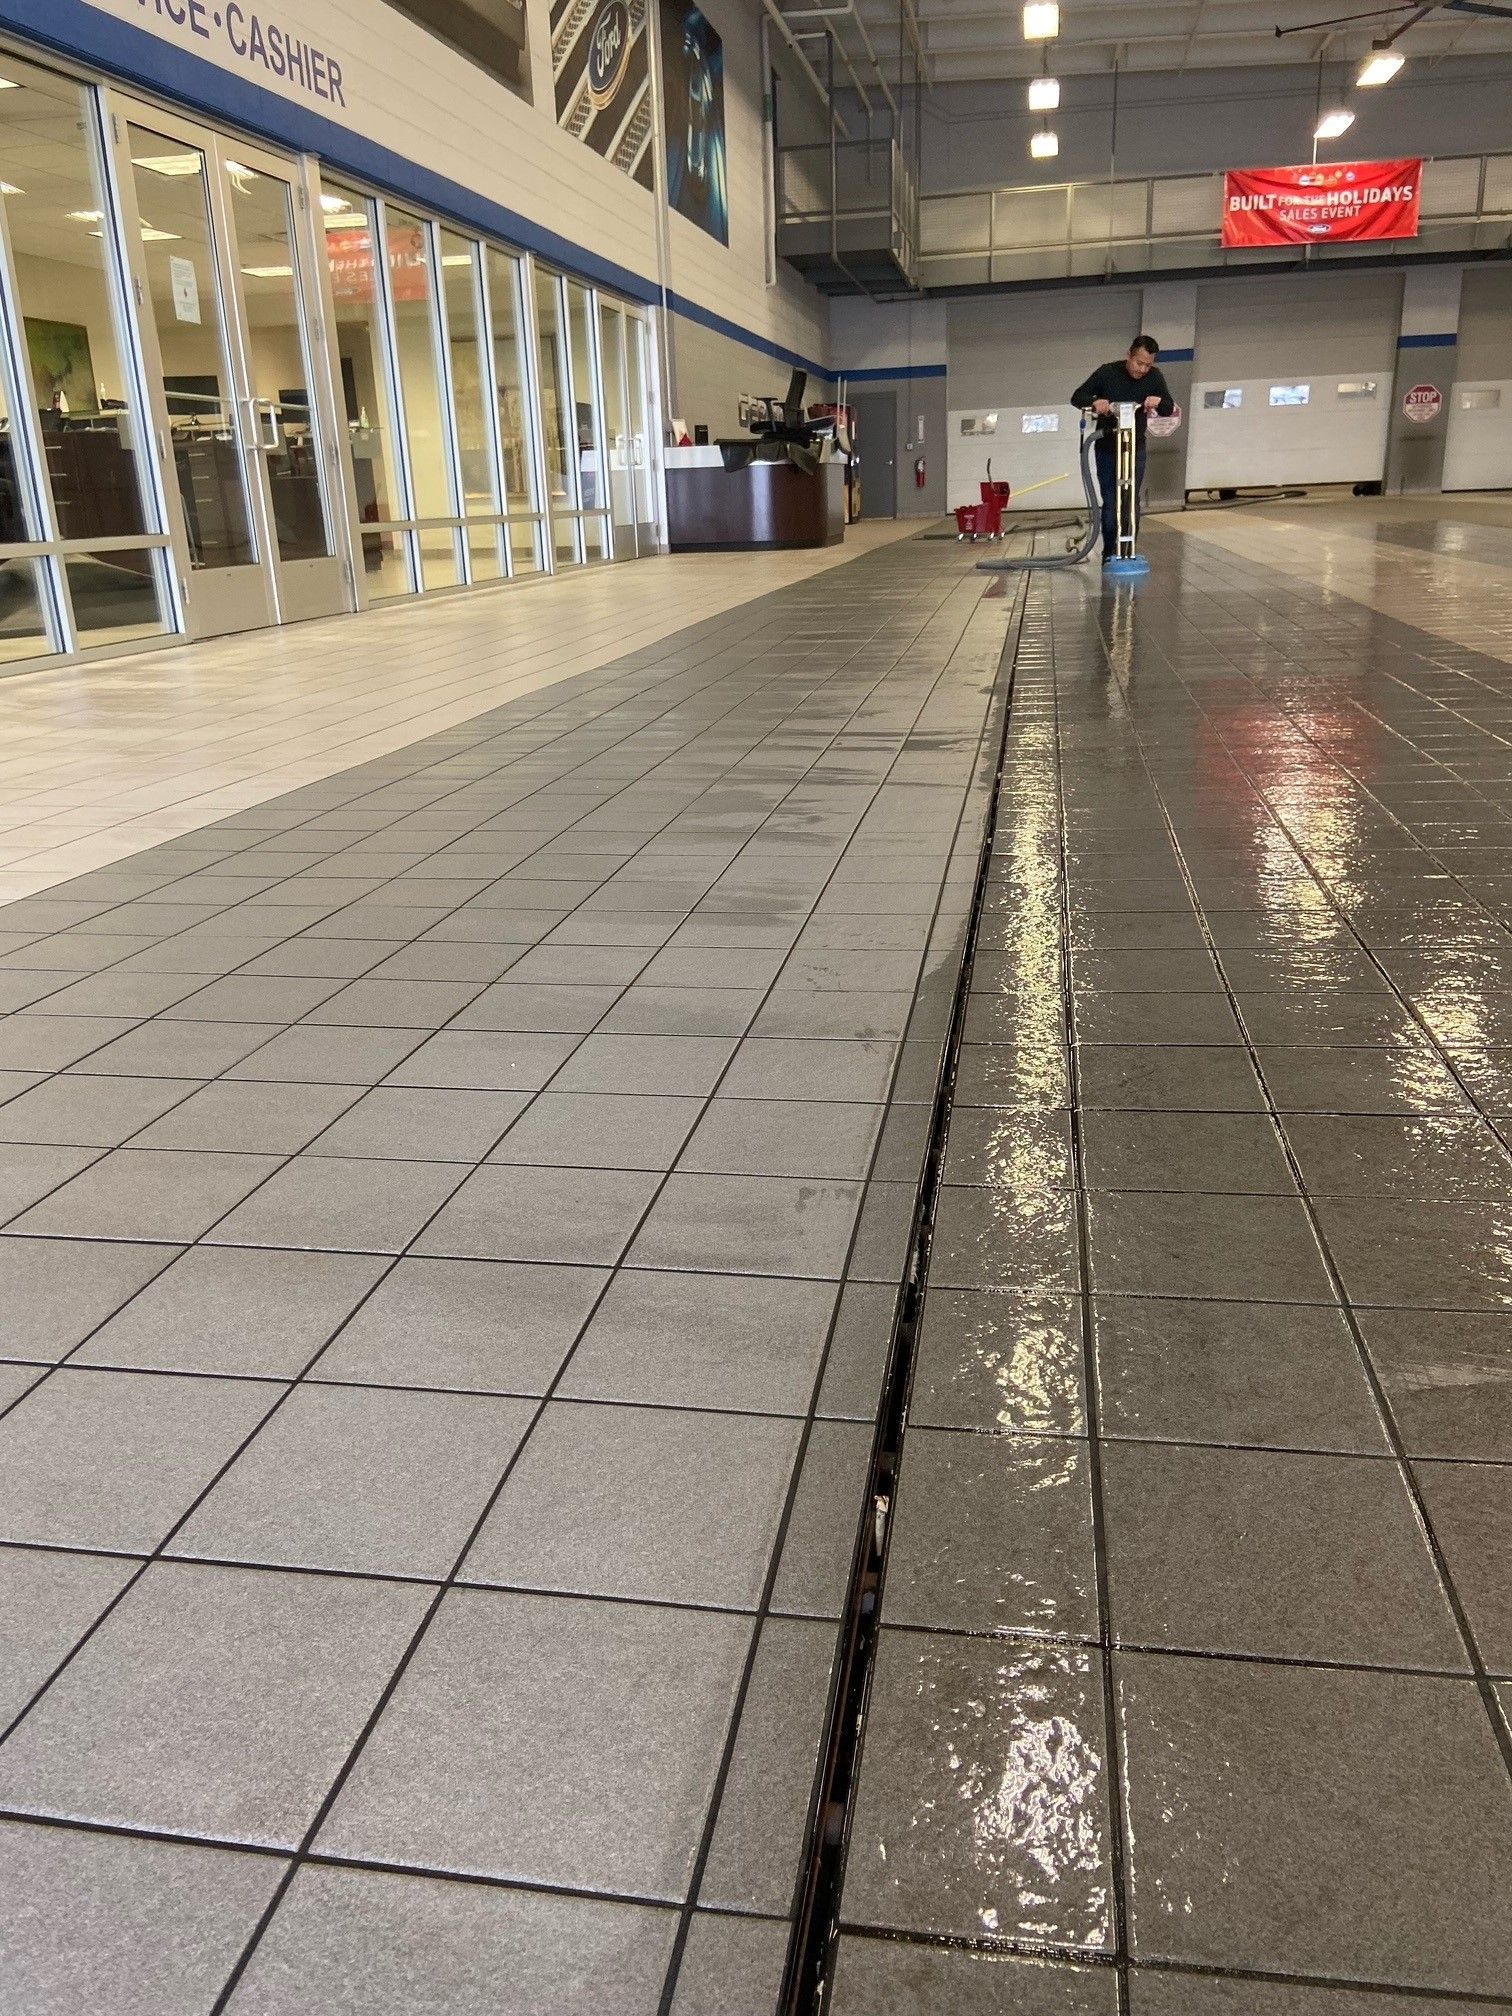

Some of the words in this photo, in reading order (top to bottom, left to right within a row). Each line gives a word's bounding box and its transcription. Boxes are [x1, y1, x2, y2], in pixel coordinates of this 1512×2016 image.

[226, 2, 346, 108] CASHIER
[596, 10, 621, 78] Ford
[1229, 193, 1277, 212] BUILT
[1326, 185, 1413, 206] HOLIDAYS
[1280, 207, 1318, 221] SALES
[1320, 204, 1362, 219] EVENT
[1409, 391, 1437, 404] STOP
